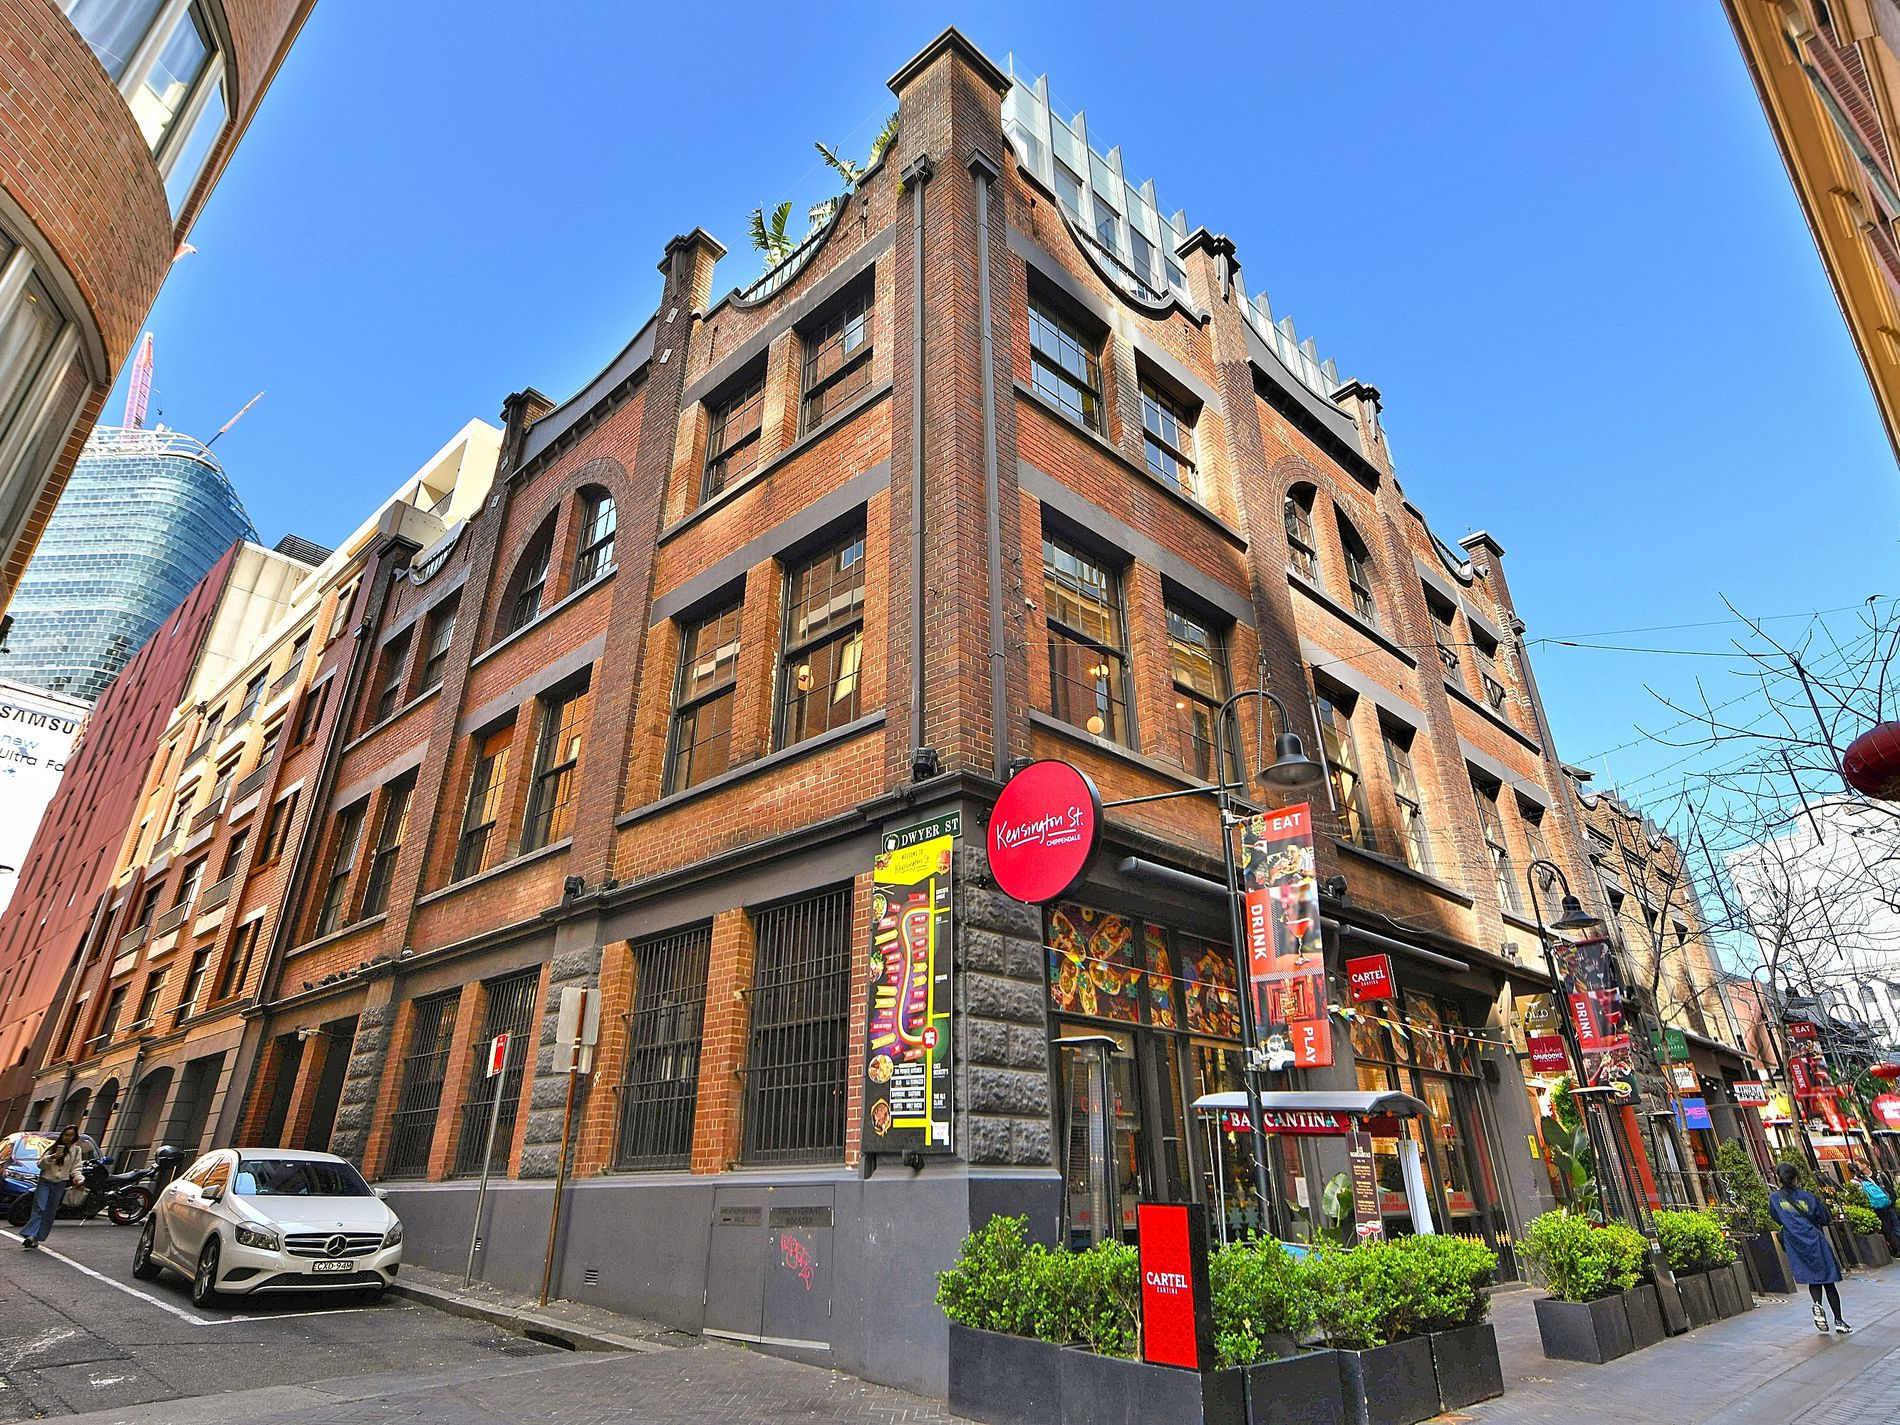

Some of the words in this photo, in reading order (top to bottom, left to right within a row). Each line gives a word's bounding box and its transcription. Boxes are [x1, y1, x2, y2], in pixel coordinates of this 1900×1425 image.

[2, 734, 40, 749] new
[996, 813, 1063, 851] Kensington
[1067, 806, 1084, 828] St.
[1272, 812, 1302, 831] EAT
[901, 824, 940, 847] DWYER
[944, 817, 959, 833] ST
[1046, 834, 1081, 847] CHIPPENDALE
[1250, 903, 1267, 961] DRINK
[1351, 969, 1386, 983] CARTEL
[1575, 1001, 1594, 1039] DRINK
[1794, 1025, 1811, 1033] EAT
[1302, 1026, 1317, 1064] PLAY
[1792, 1064, 1807, 1089] DRINK
[1229, 1112, 1251, 1127] BA
[1263, 1111, 1340, 1128] CANTINA
[785, 1217, 814, 1225] BOOSTER
[1146, 1271, 1188, 1289] CARTEL
